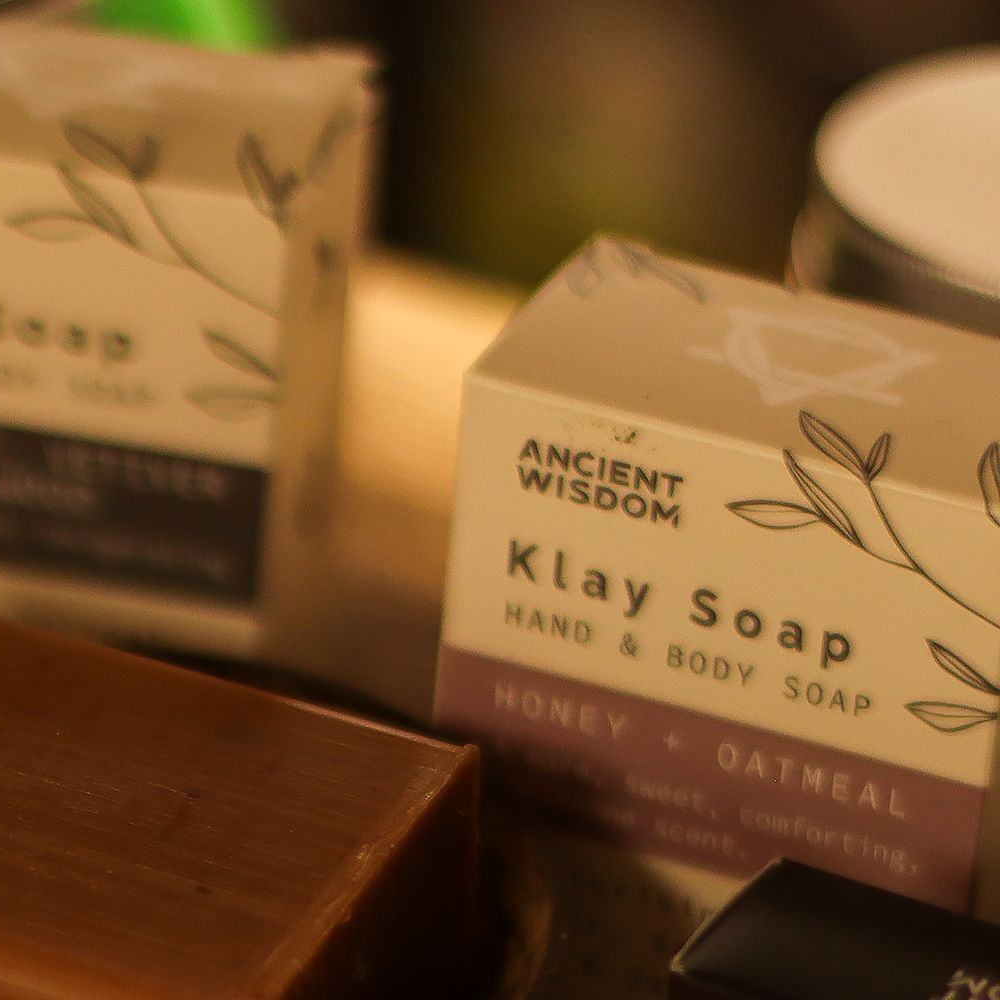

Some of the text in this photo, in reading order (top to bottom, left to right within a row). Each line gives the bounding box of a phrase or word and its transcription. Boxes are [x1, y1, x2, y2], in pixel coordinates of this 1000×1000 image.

[517, 464, 683, 529] WISDOM
[518, 437, 685, 498] ANCIENT
[504, 601, 873, 717] HAND & BODY SOAP
[506, 538, 854, 669] Klay Soap
[494, 684, 628, 741] HONEY
[717, 741, 908, 820] OATMEAL
